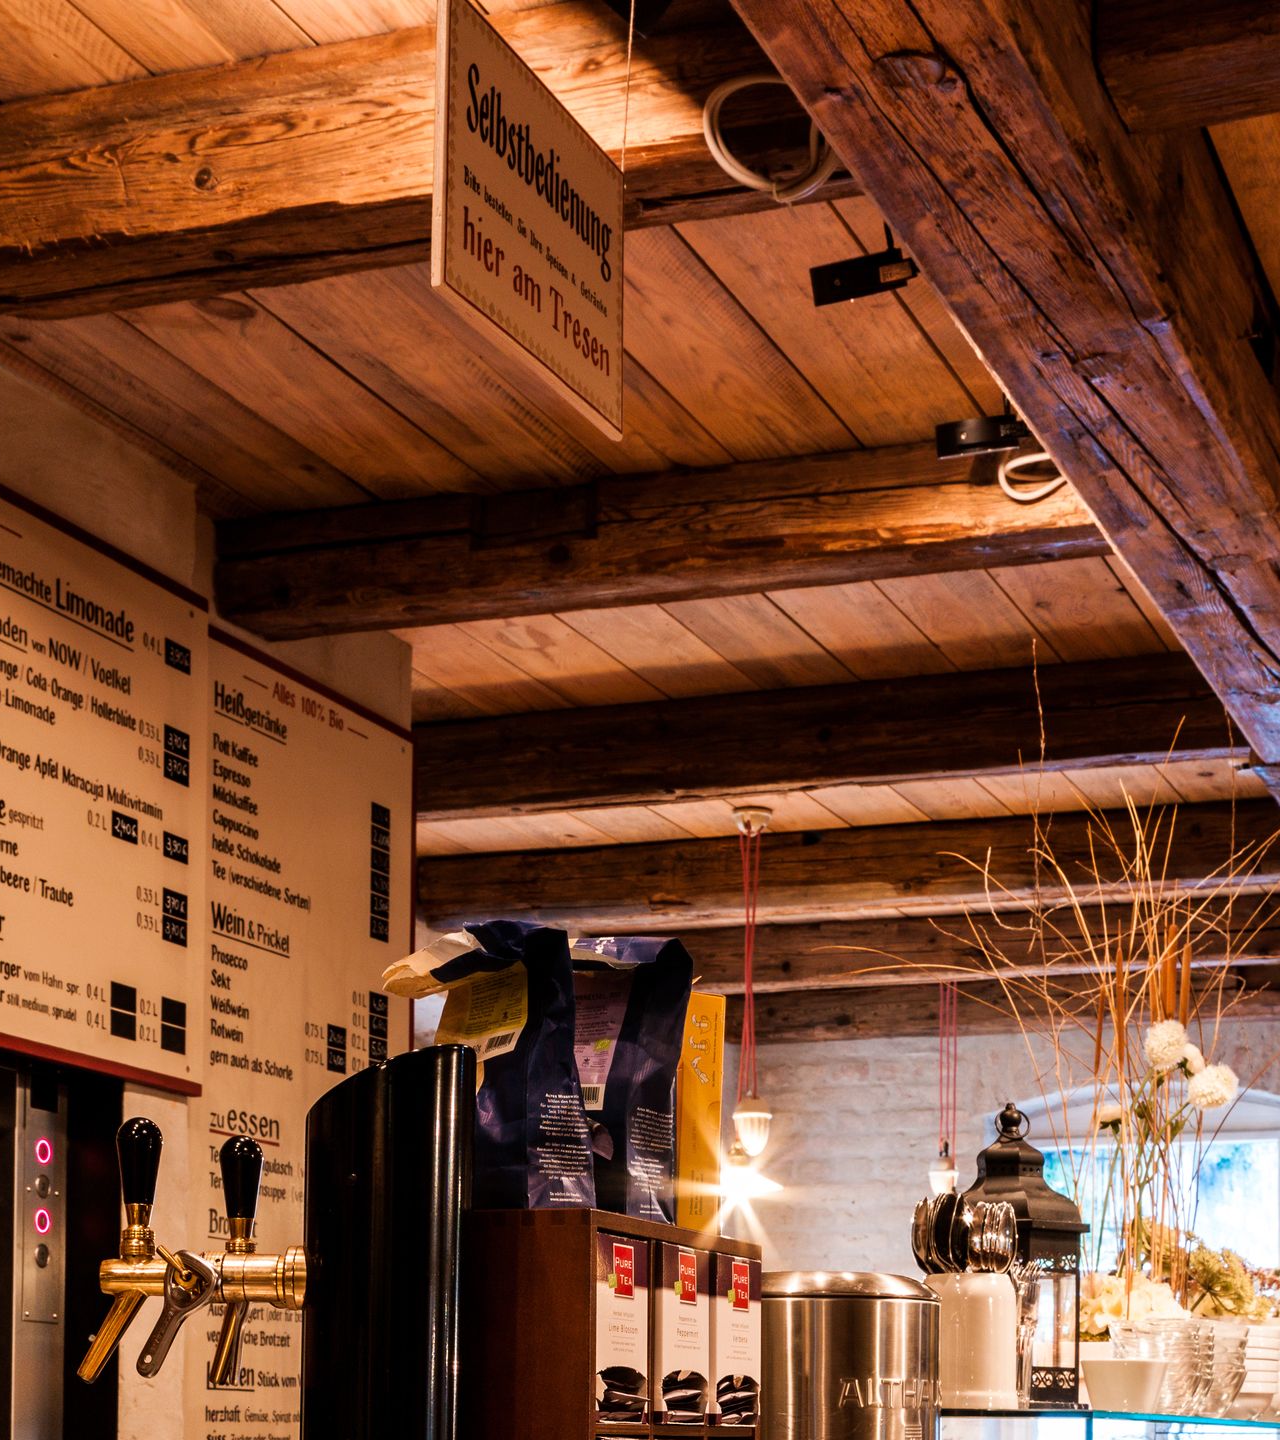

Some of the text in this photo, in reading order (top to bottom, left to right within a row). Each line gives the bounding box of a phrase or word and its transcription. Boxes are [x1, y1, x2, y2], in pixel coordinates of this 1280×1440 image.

[466, 63, 612, 282] Selbstbedienung
[464, 165, 480, 195] Bitte
[484, 186, 513, 226] bestellen
[518, 218, 526, 238] Sie
[530, 230, 542, 253] Ihre
[546, 246, 568, 279] Speisen
[581, 281, 607, 317] Getränke
[464, 206, 610, 377] hier am Tresen
[56, 578, 134, 642] Limonade
[32, 640, 46, 654] von
[49, 638, 81, 671] NOW
[91, 658, 131, 696] Voelkel
[214, 680, 287, 740] Heißgetränke
[273, 682, 295, 708] Alles
[330, 709, 344, 731] Bio
[35, 754, 58, 780] Apfel
[62, 766, 103, 800] Maracuja
[107, 784, 163, 821] Multivitamin
[213, 759, 251, 788] Espresso
[213, 784, 258, 816] Milchkaffee
[8, 808, 44, 830] gespritzt
[213, 809, 258, 840] Cappuccino
[212, 834, 281, 874] heiße Schokolade
[212, 860, 225, 880] Tee
[39, 878, 74, 907] Traube
[211, 901, 290, 954] Wein & Prickel
[212, 944, 247, 971] Prosecco
[24, 970, 39, 983] vom
[42, 970, 63, 990] Hahn
[211, 969, 231, 991] Sekt
[210, 995, 249, 1020] Weißwein
[210, 1019, 243, 1043] Rotwein
[210, 1049, 293, 1081] gern auch als Schorle
[210, 1109, 280, 1140] zu essen
[616, 1257, 632, 1270] PURE
[680, 1264, 695, 1276] PURE
[620, 1275, 632, 1286] TEA
[684, 1281, 695, 1292] TEA
[734, 1274, 748, 1284] PURE
[738, 1290, 748, 1300] TEA
[260, 1331, 290, 1347] Brotzeit
[257, 1371, 296, 1387] Stück vom
[205, 1406, 240, 1423] herzhaft
